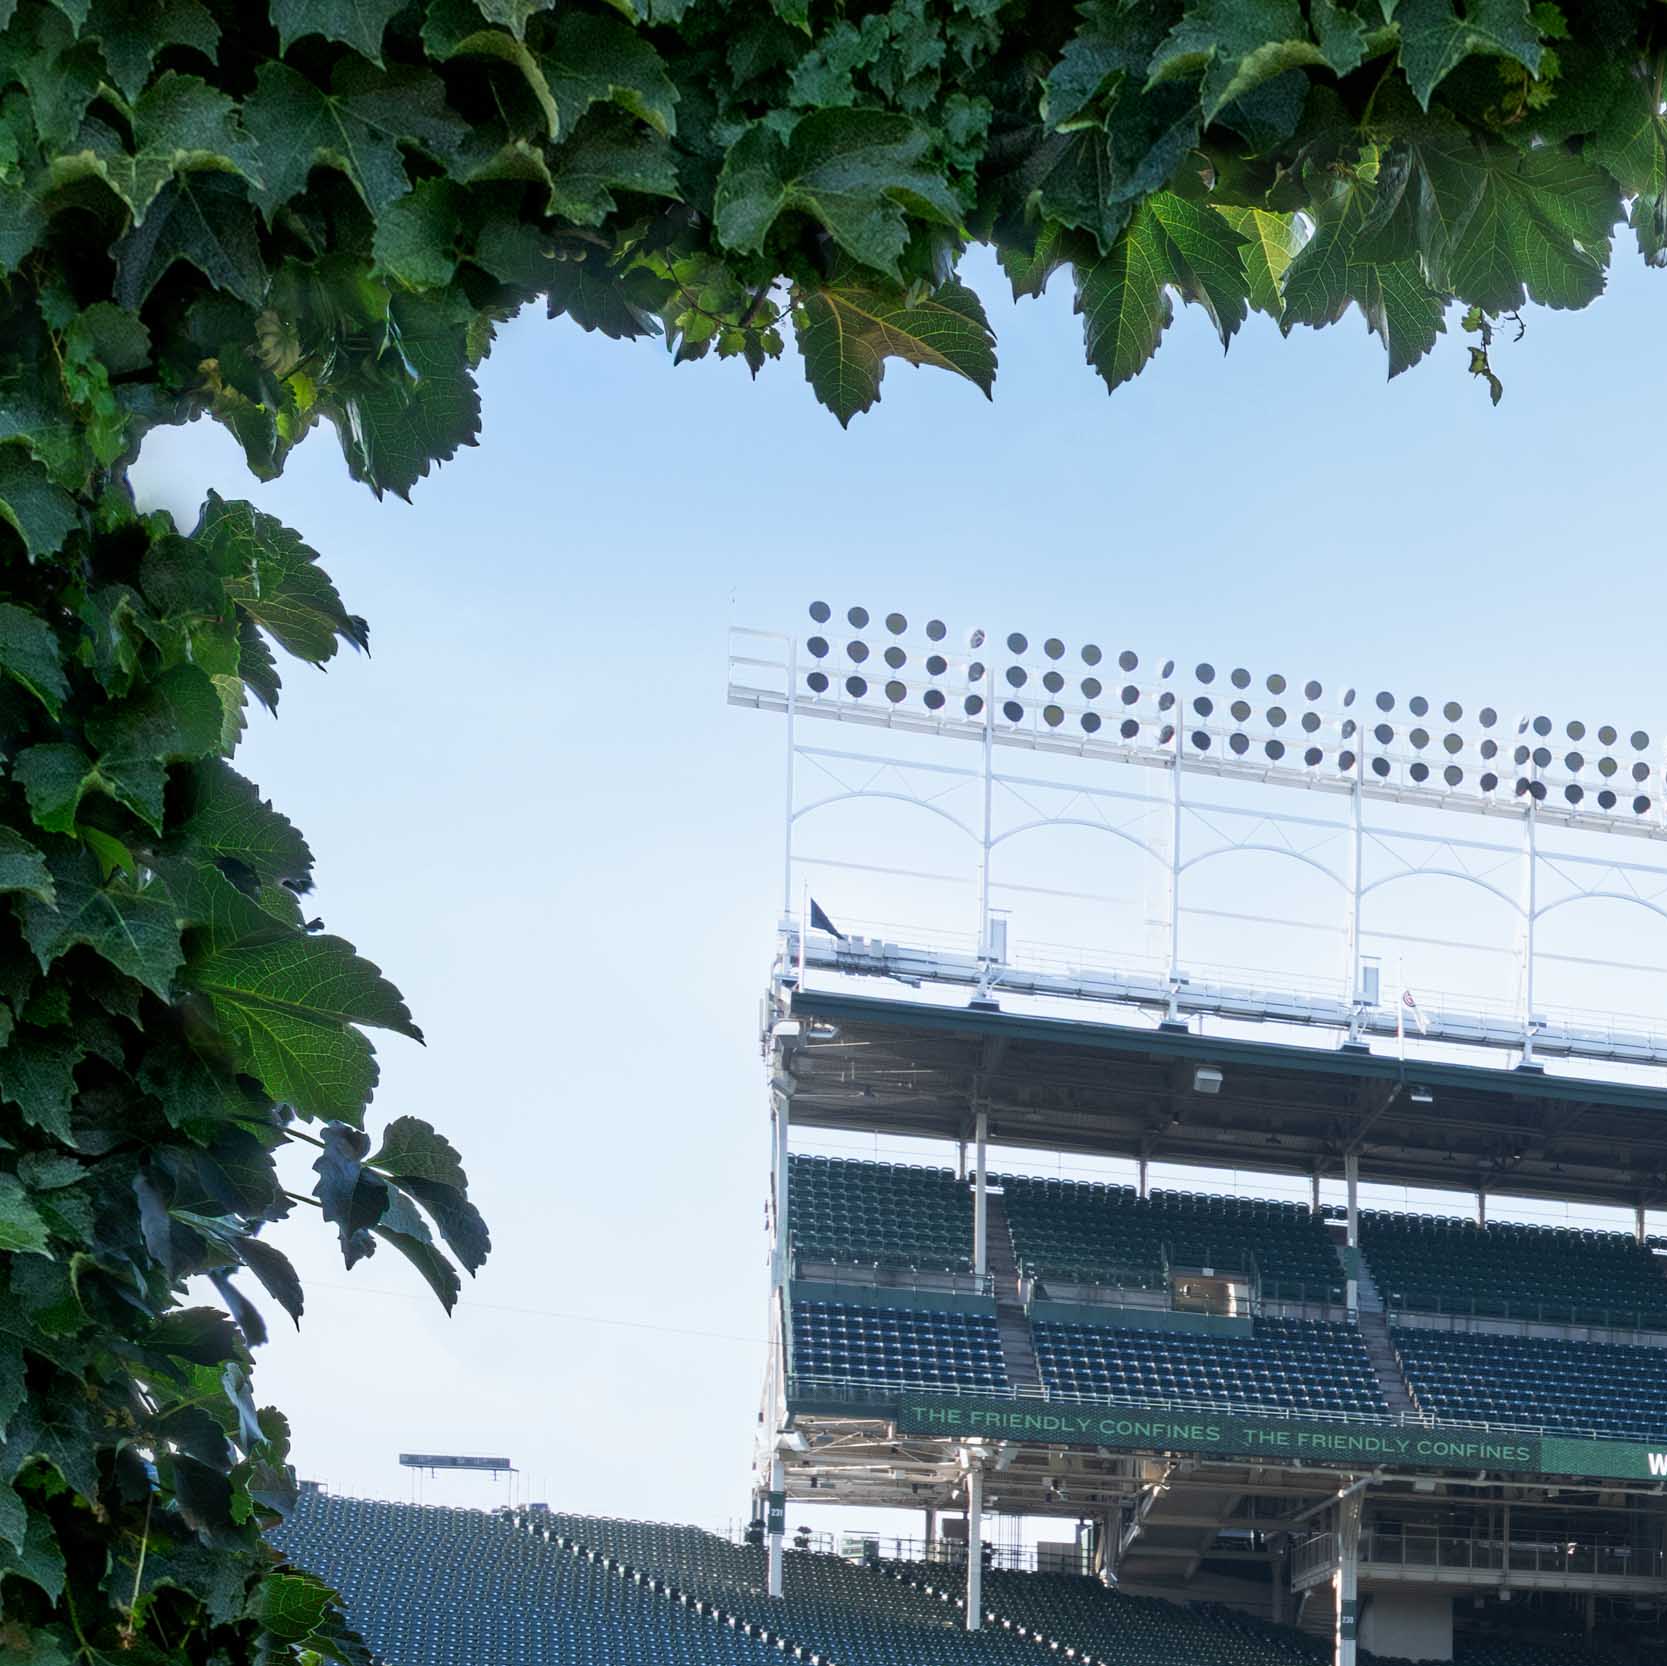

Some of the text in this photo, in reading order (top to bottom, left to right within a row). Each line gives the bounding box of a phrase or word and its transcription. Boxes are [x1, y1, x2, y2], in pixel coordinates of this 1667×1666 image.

[912, 1407, 1221, 1441] THE FRIENDLY CONFINES
[1243, 1429, 1530, 1462] THE FRIENDLY CONFINES
[770, 1508, 784, 1517] 231
